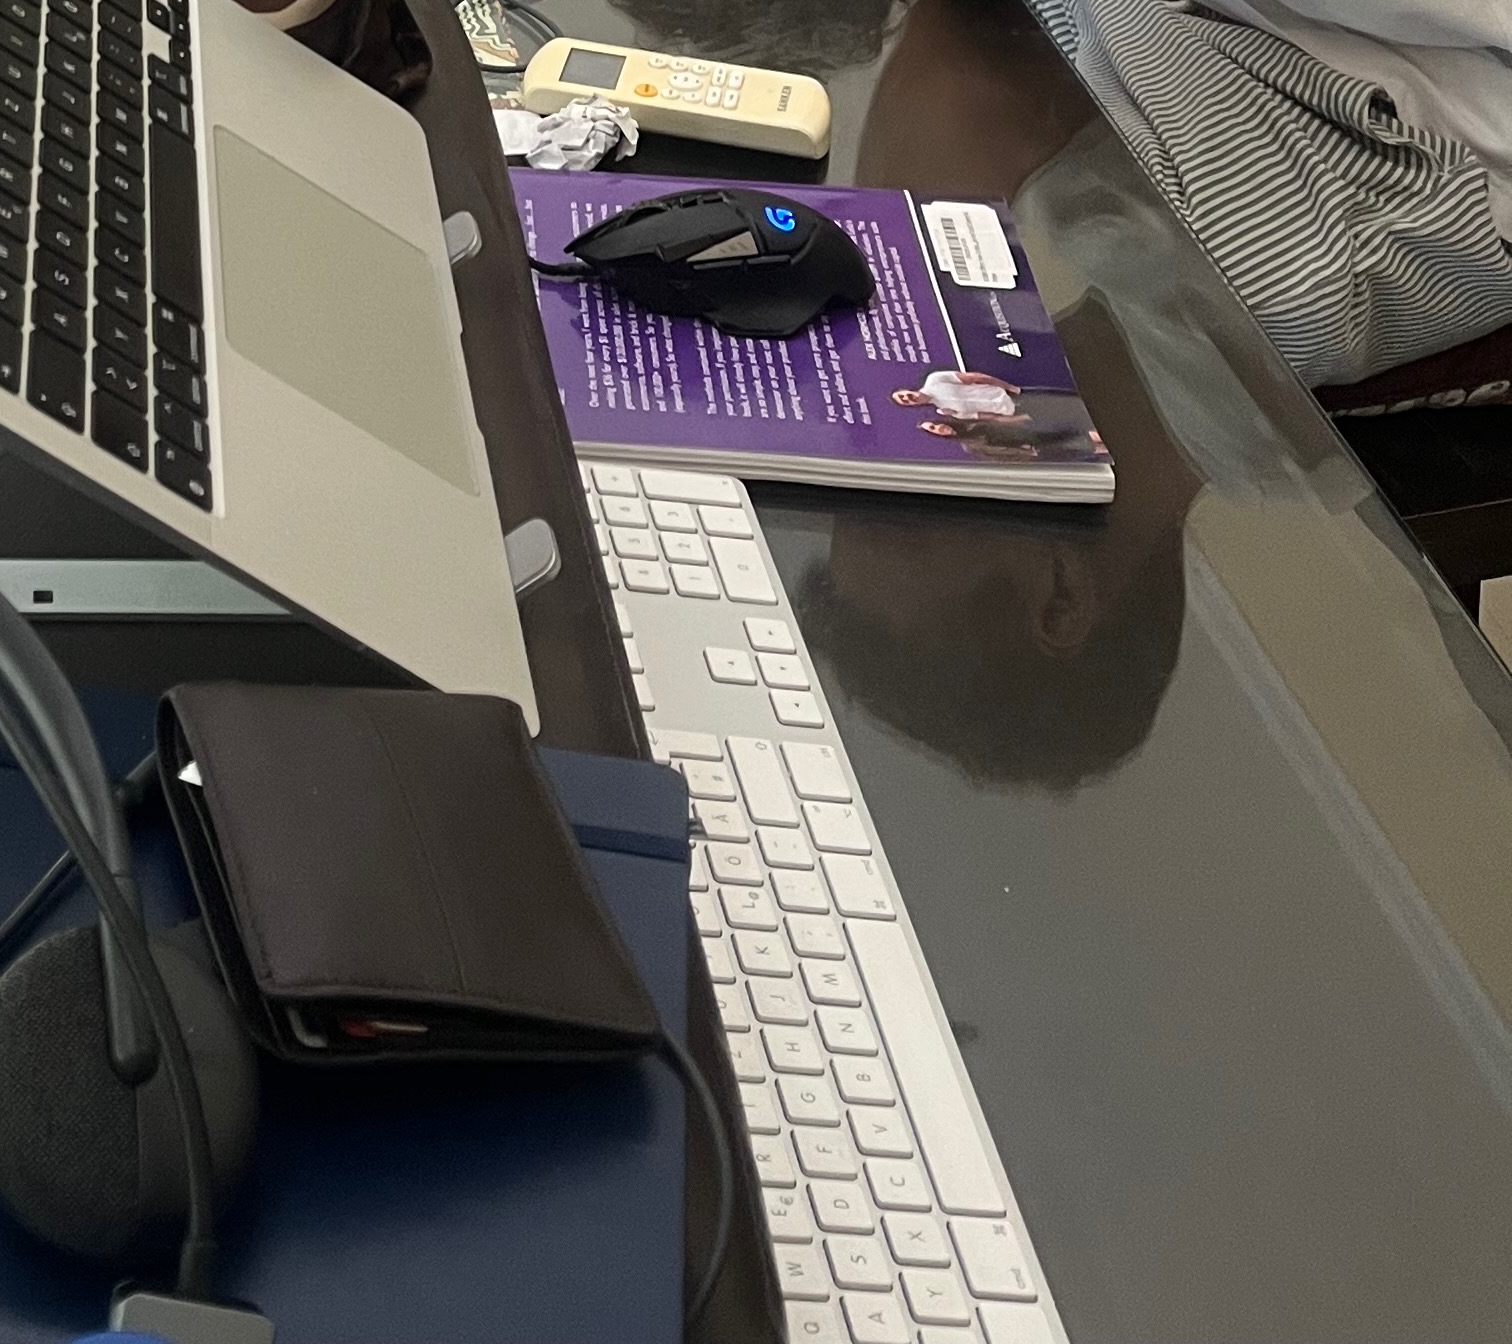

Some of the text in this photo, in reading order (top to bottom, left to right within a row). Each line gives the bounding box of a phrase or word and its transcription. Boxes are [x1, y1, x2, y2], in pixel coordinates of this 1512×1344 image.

[754, 946, 770, 955] K
[822, 973, 839, 986] M
[839, 1022, 855, 1033] N
[785, 1042, 801, 1052] H
[856, 1073, 871, 1082] B
[800, 1092, 816, 1103] G
[872, 1124, 888, 1134] V
[816, 1145, 833, 1154] F
[755, 1153, 771, 1162] R
[890, 1176, 905, 1187] C
[833, 1199, 850, 1209] D
[771, 1208, 788, 1217] E
[908, 1231, 927, 1243] X
[850, 1255, 867, 1264] S
[786, 1262, 805, 1277] W
[926, 1288, 943, 1298] Y
[868, 1312, 885, 1325] A
[803, 1321, 820, 1334] Q
